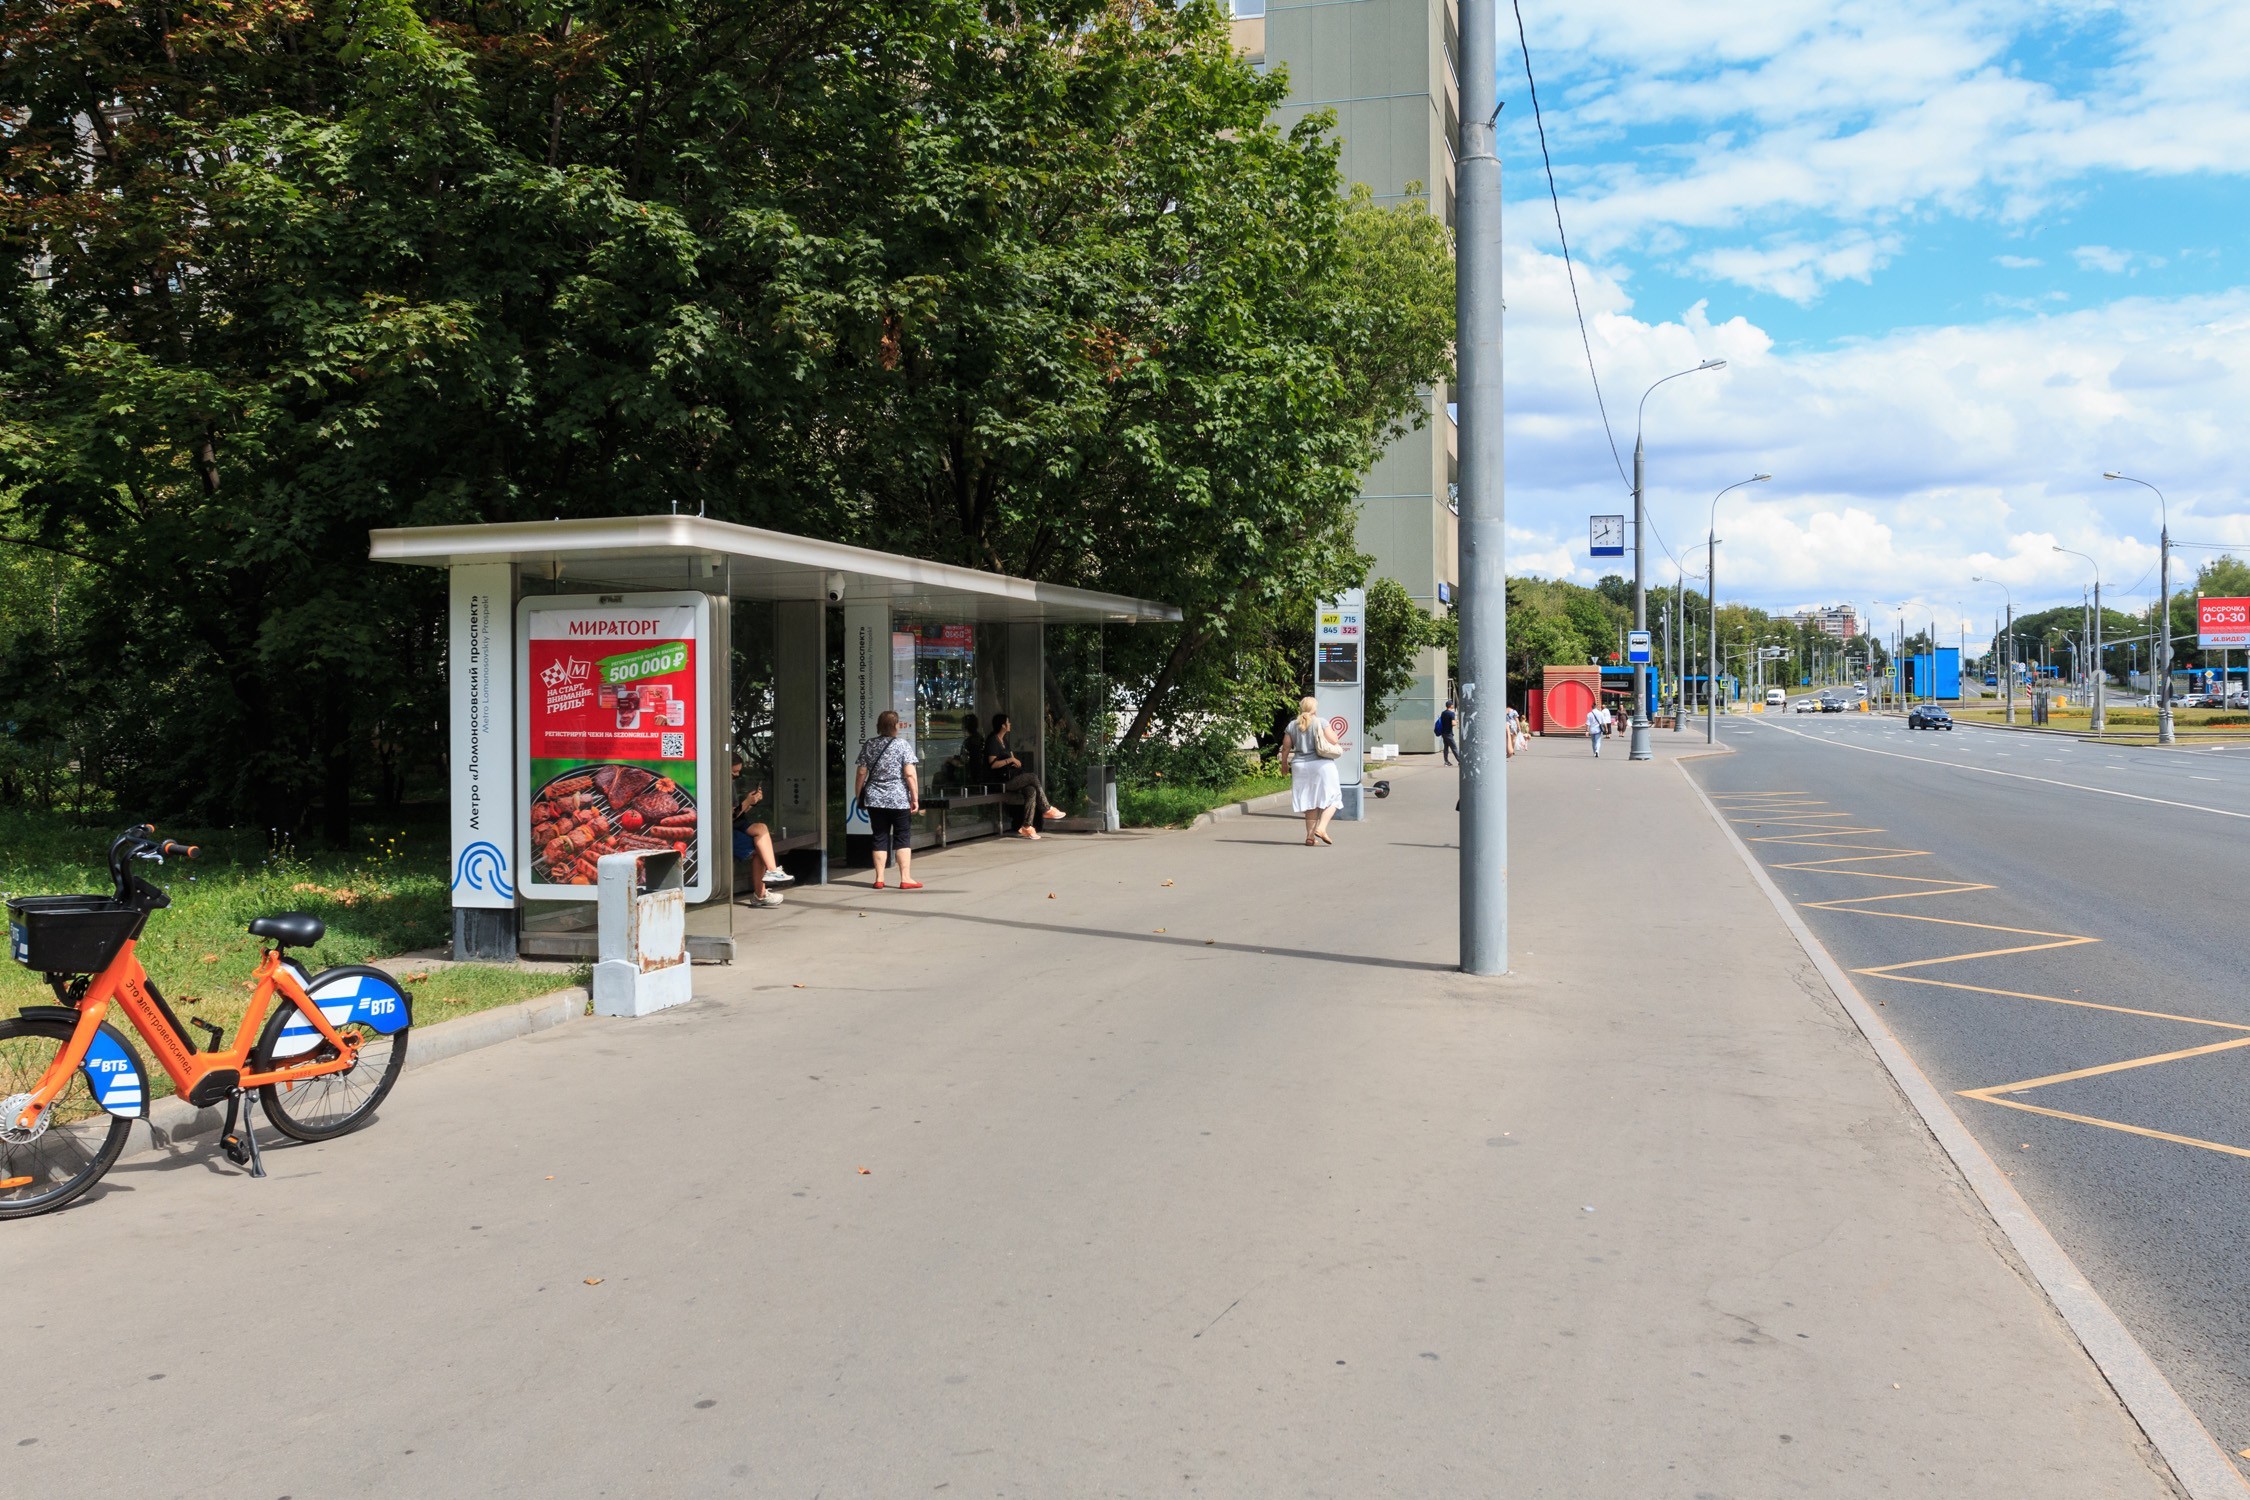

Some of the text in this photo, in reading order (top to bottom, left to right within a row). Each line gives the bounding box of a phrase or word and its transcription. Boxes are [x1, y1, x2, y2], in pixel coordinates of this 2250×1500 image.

[482, 596, 490, 633] Prospekt
[2203, 613, 2246, 623] 0-0-30
[568, 620, 660, 635] МИРАТОРГ
[1323, 626, 1357, 634] 845 325
[482, 635, 490, 703] Lomonosovskiy
[610, 652, 684, 682] 500 000 ₽
[547, 682, 585, 697] НА СТАРТ,
[547, 688, 594, 704] ВНИМАНИЕ,
[469, 595, 480, 830] Метро «Ломоносовский проспект»
[546, 698, 585, 714] ГРИЛЬ!
[858, 674, 866, 747] Ломоносовский
[371, 998, 396, 1016] ВТБ
[126, 979, 192, 1076] Это электровелосипед.
[101, 1059, 128, 1072] ВТБ
